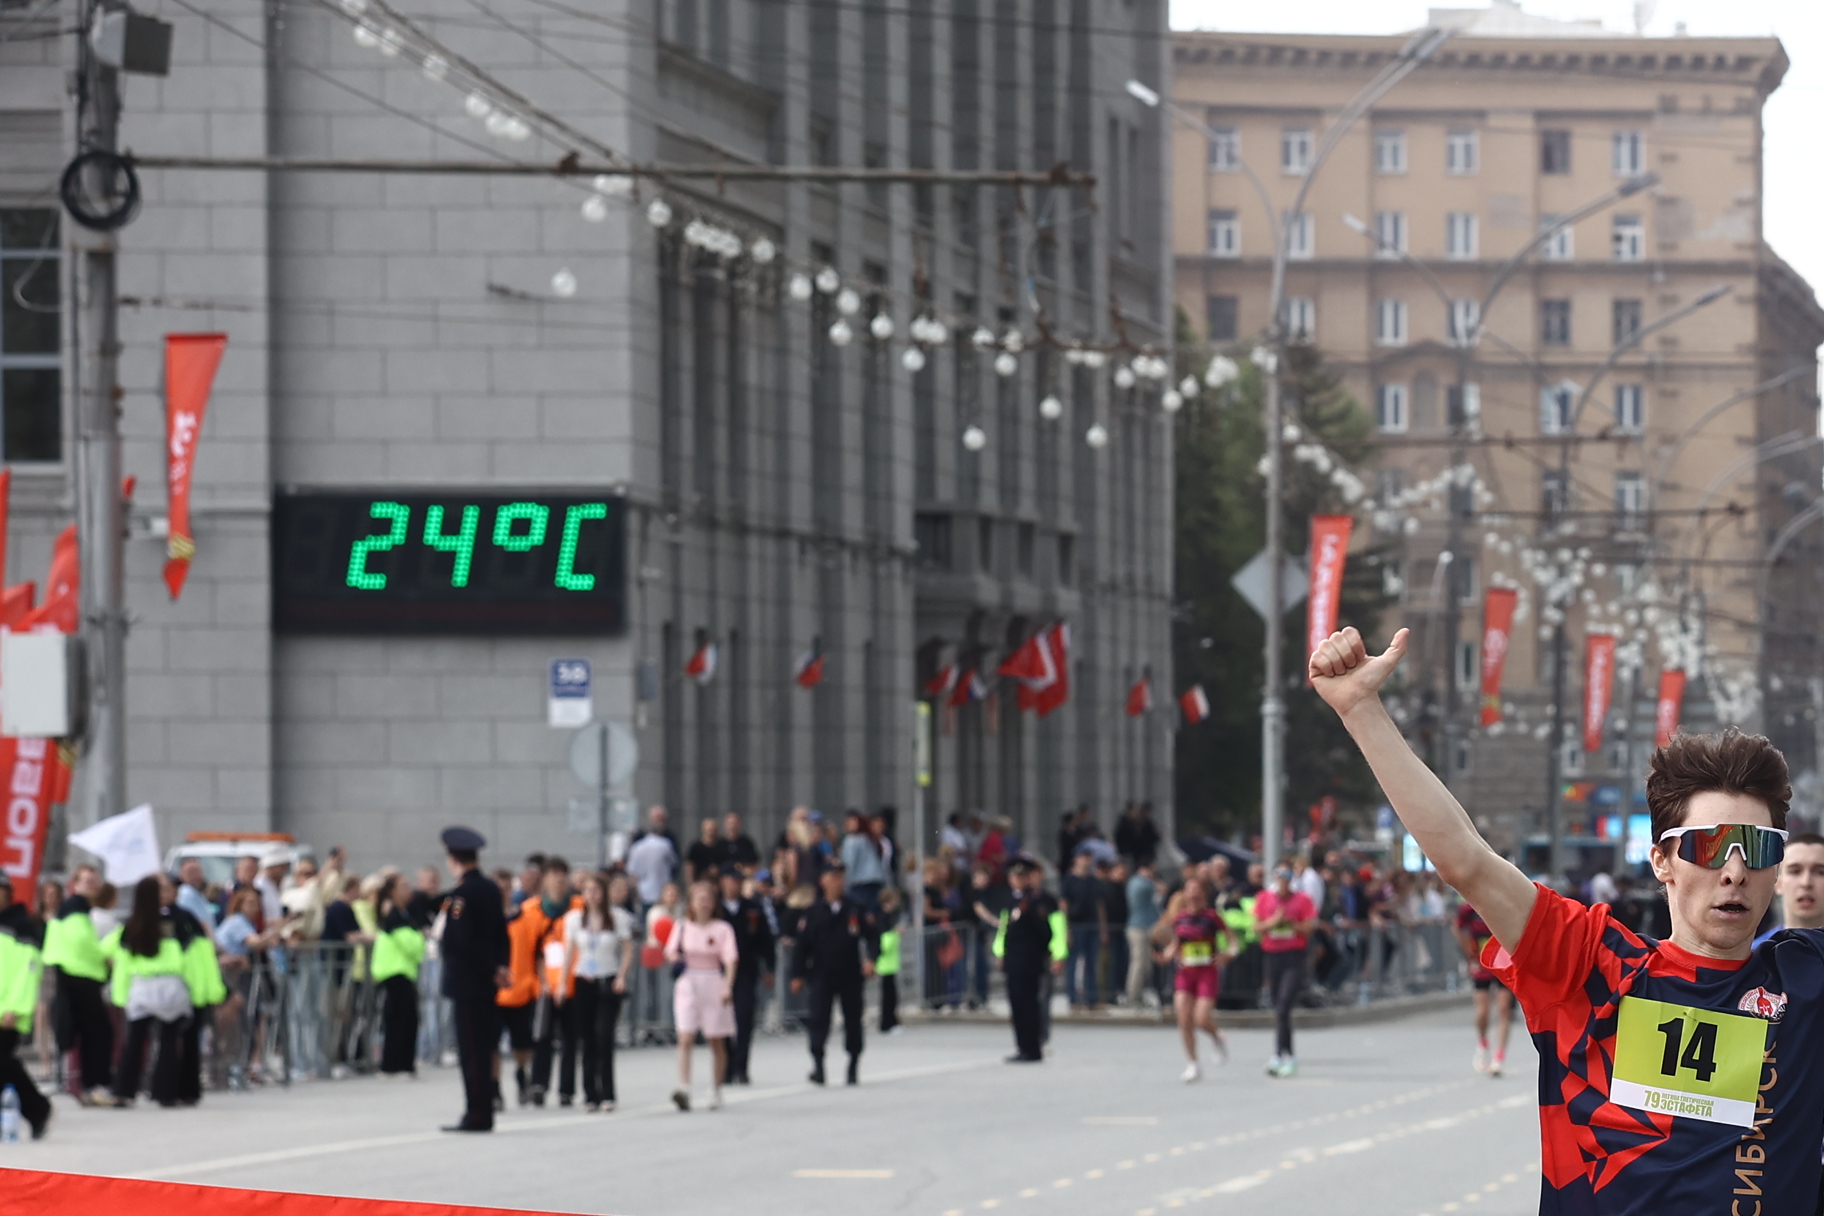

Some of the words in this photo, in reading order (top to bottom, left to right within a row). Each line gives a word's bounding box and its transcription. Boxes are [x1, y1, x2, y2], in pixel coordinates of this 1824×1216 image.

[1657, 1017, 1718, 1082] 14
[1644, 1090, 1661, 1109] 79
[1660, 1099, 1713, 1117] ЭСТАФЕТА
